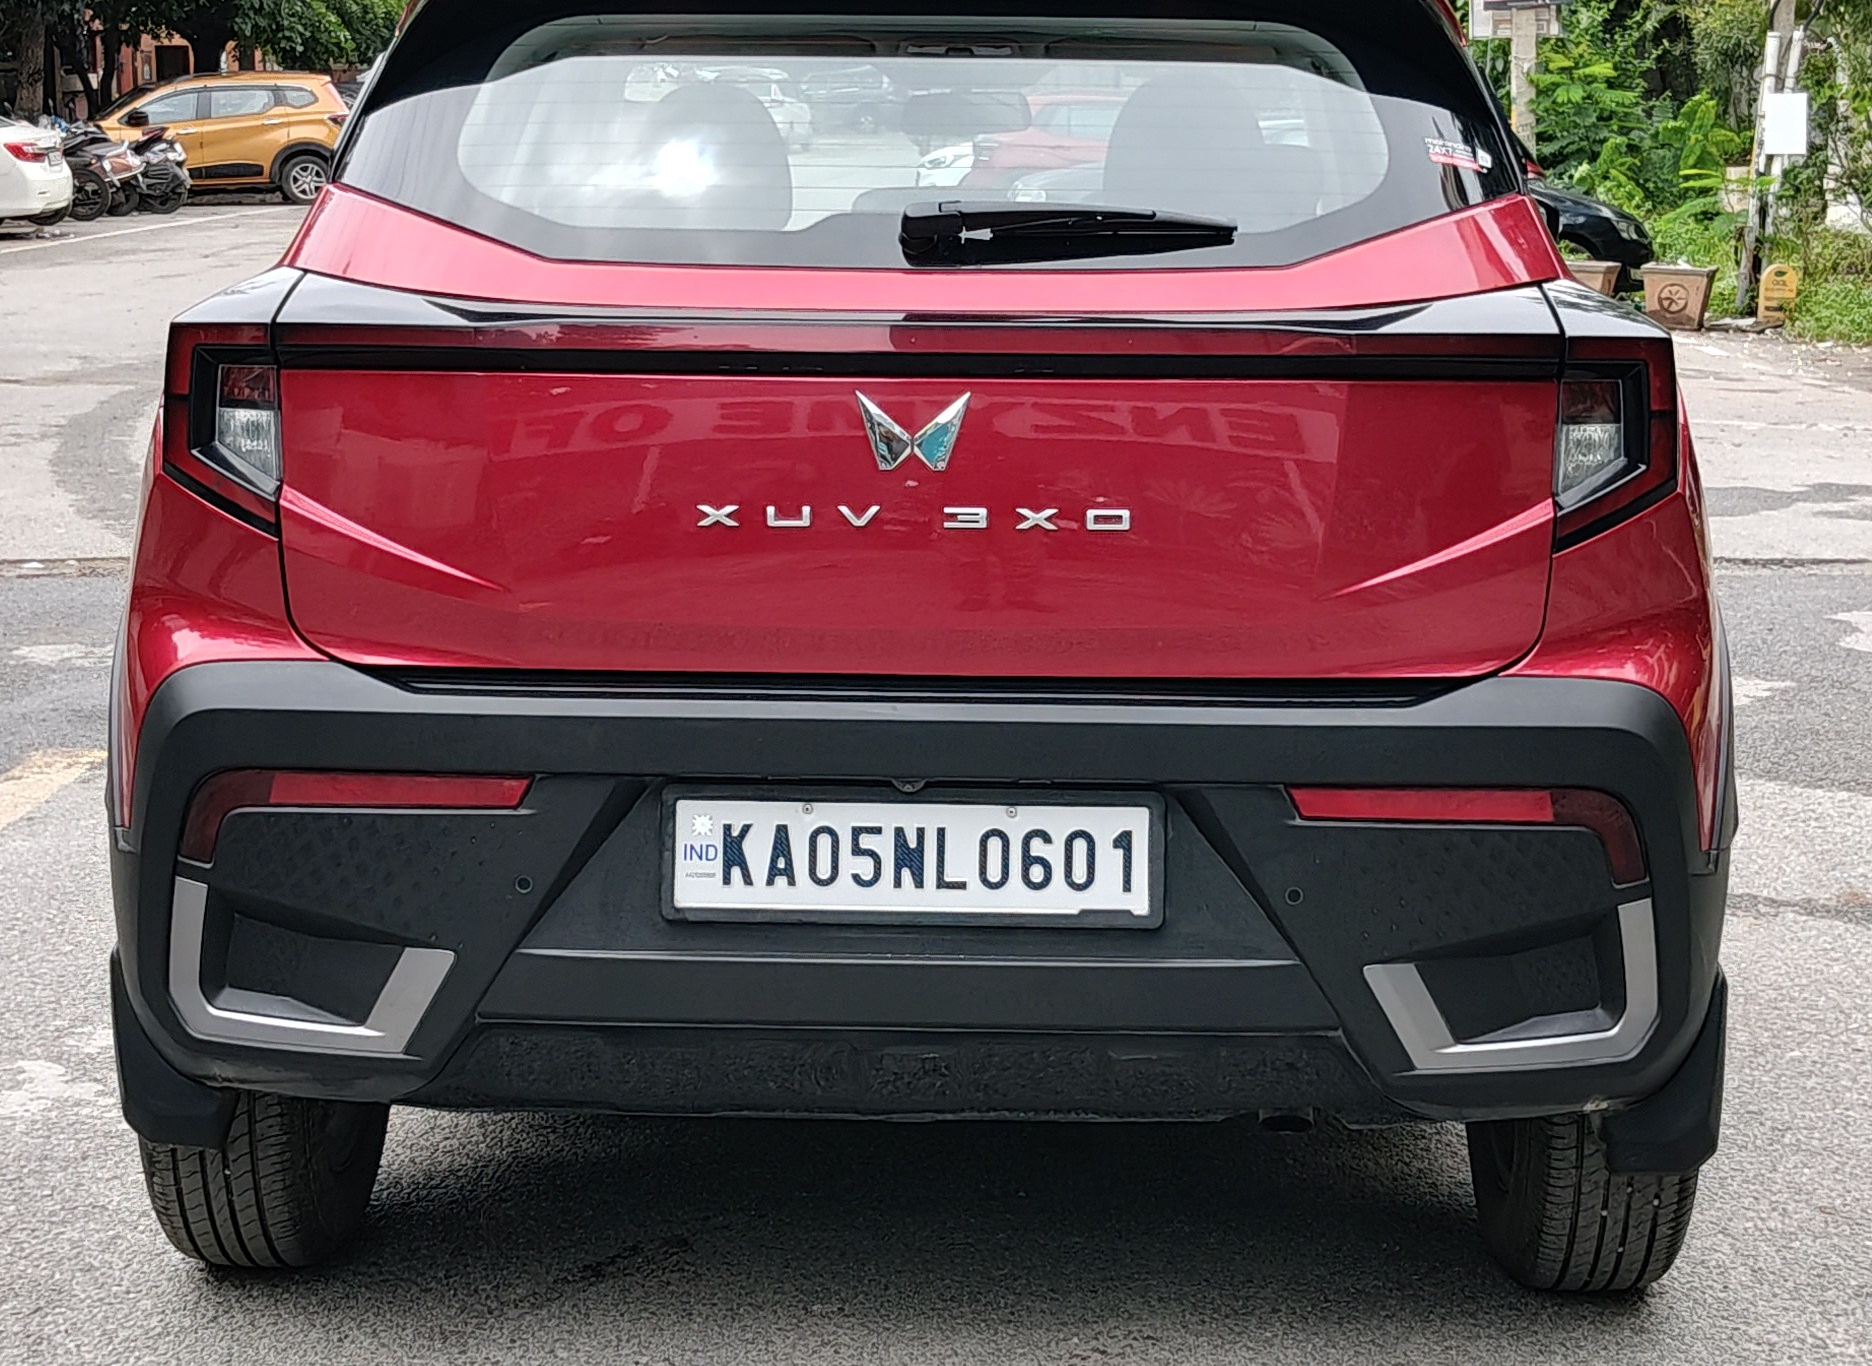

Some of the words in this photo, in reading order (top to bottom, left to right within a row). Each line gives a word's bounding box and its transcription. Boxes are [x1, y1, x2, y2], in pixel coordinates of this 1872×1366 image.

[696, 504, 881, 528] XUV
[683, 843, 718, 862] IND
[722, 822, 1134, 894] KA05NL0601
